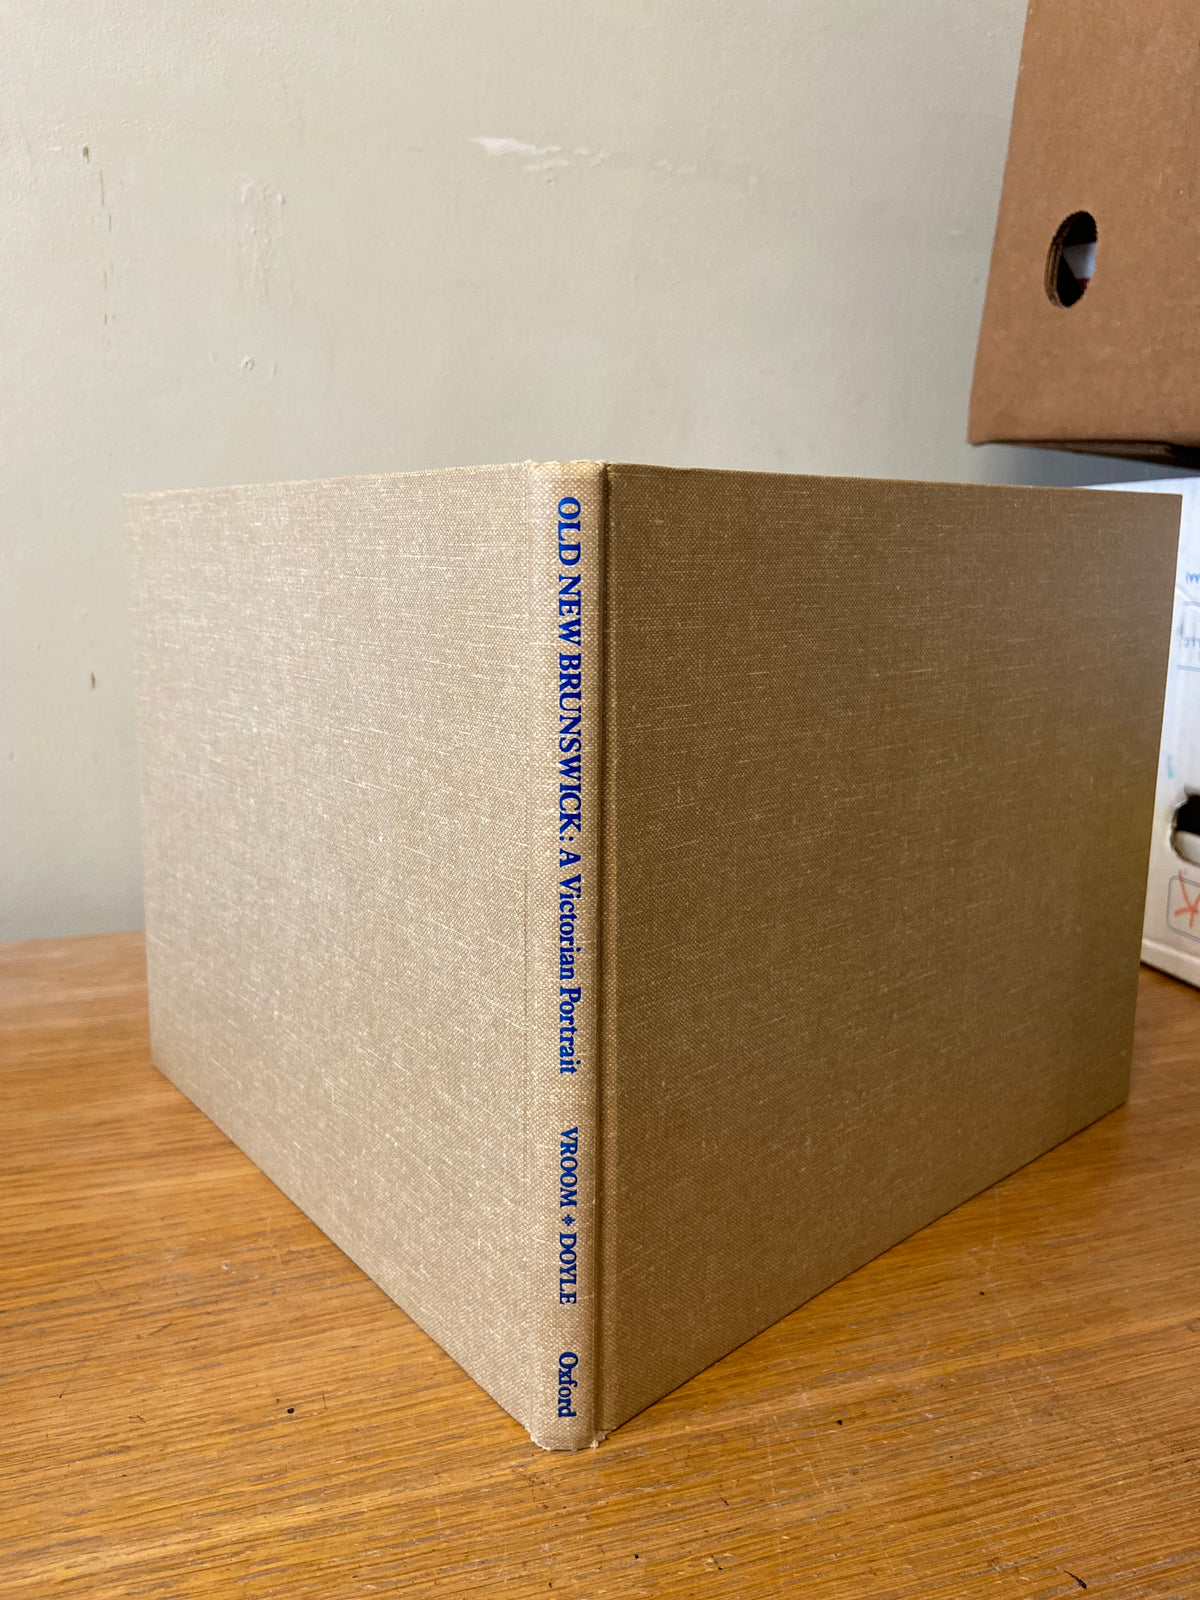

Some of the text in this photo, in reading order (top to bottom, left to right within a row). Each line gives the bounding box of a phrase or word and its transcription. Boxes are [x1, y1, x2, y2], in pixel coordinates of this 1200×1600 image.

[557, 496, 582, 1075] OLD NEW BRUNSWICK: A Victorian Portrait
[559, 1126, 579, 1305] VROOM DOYLE
[557, 1351, 579, 1418] Oxford
